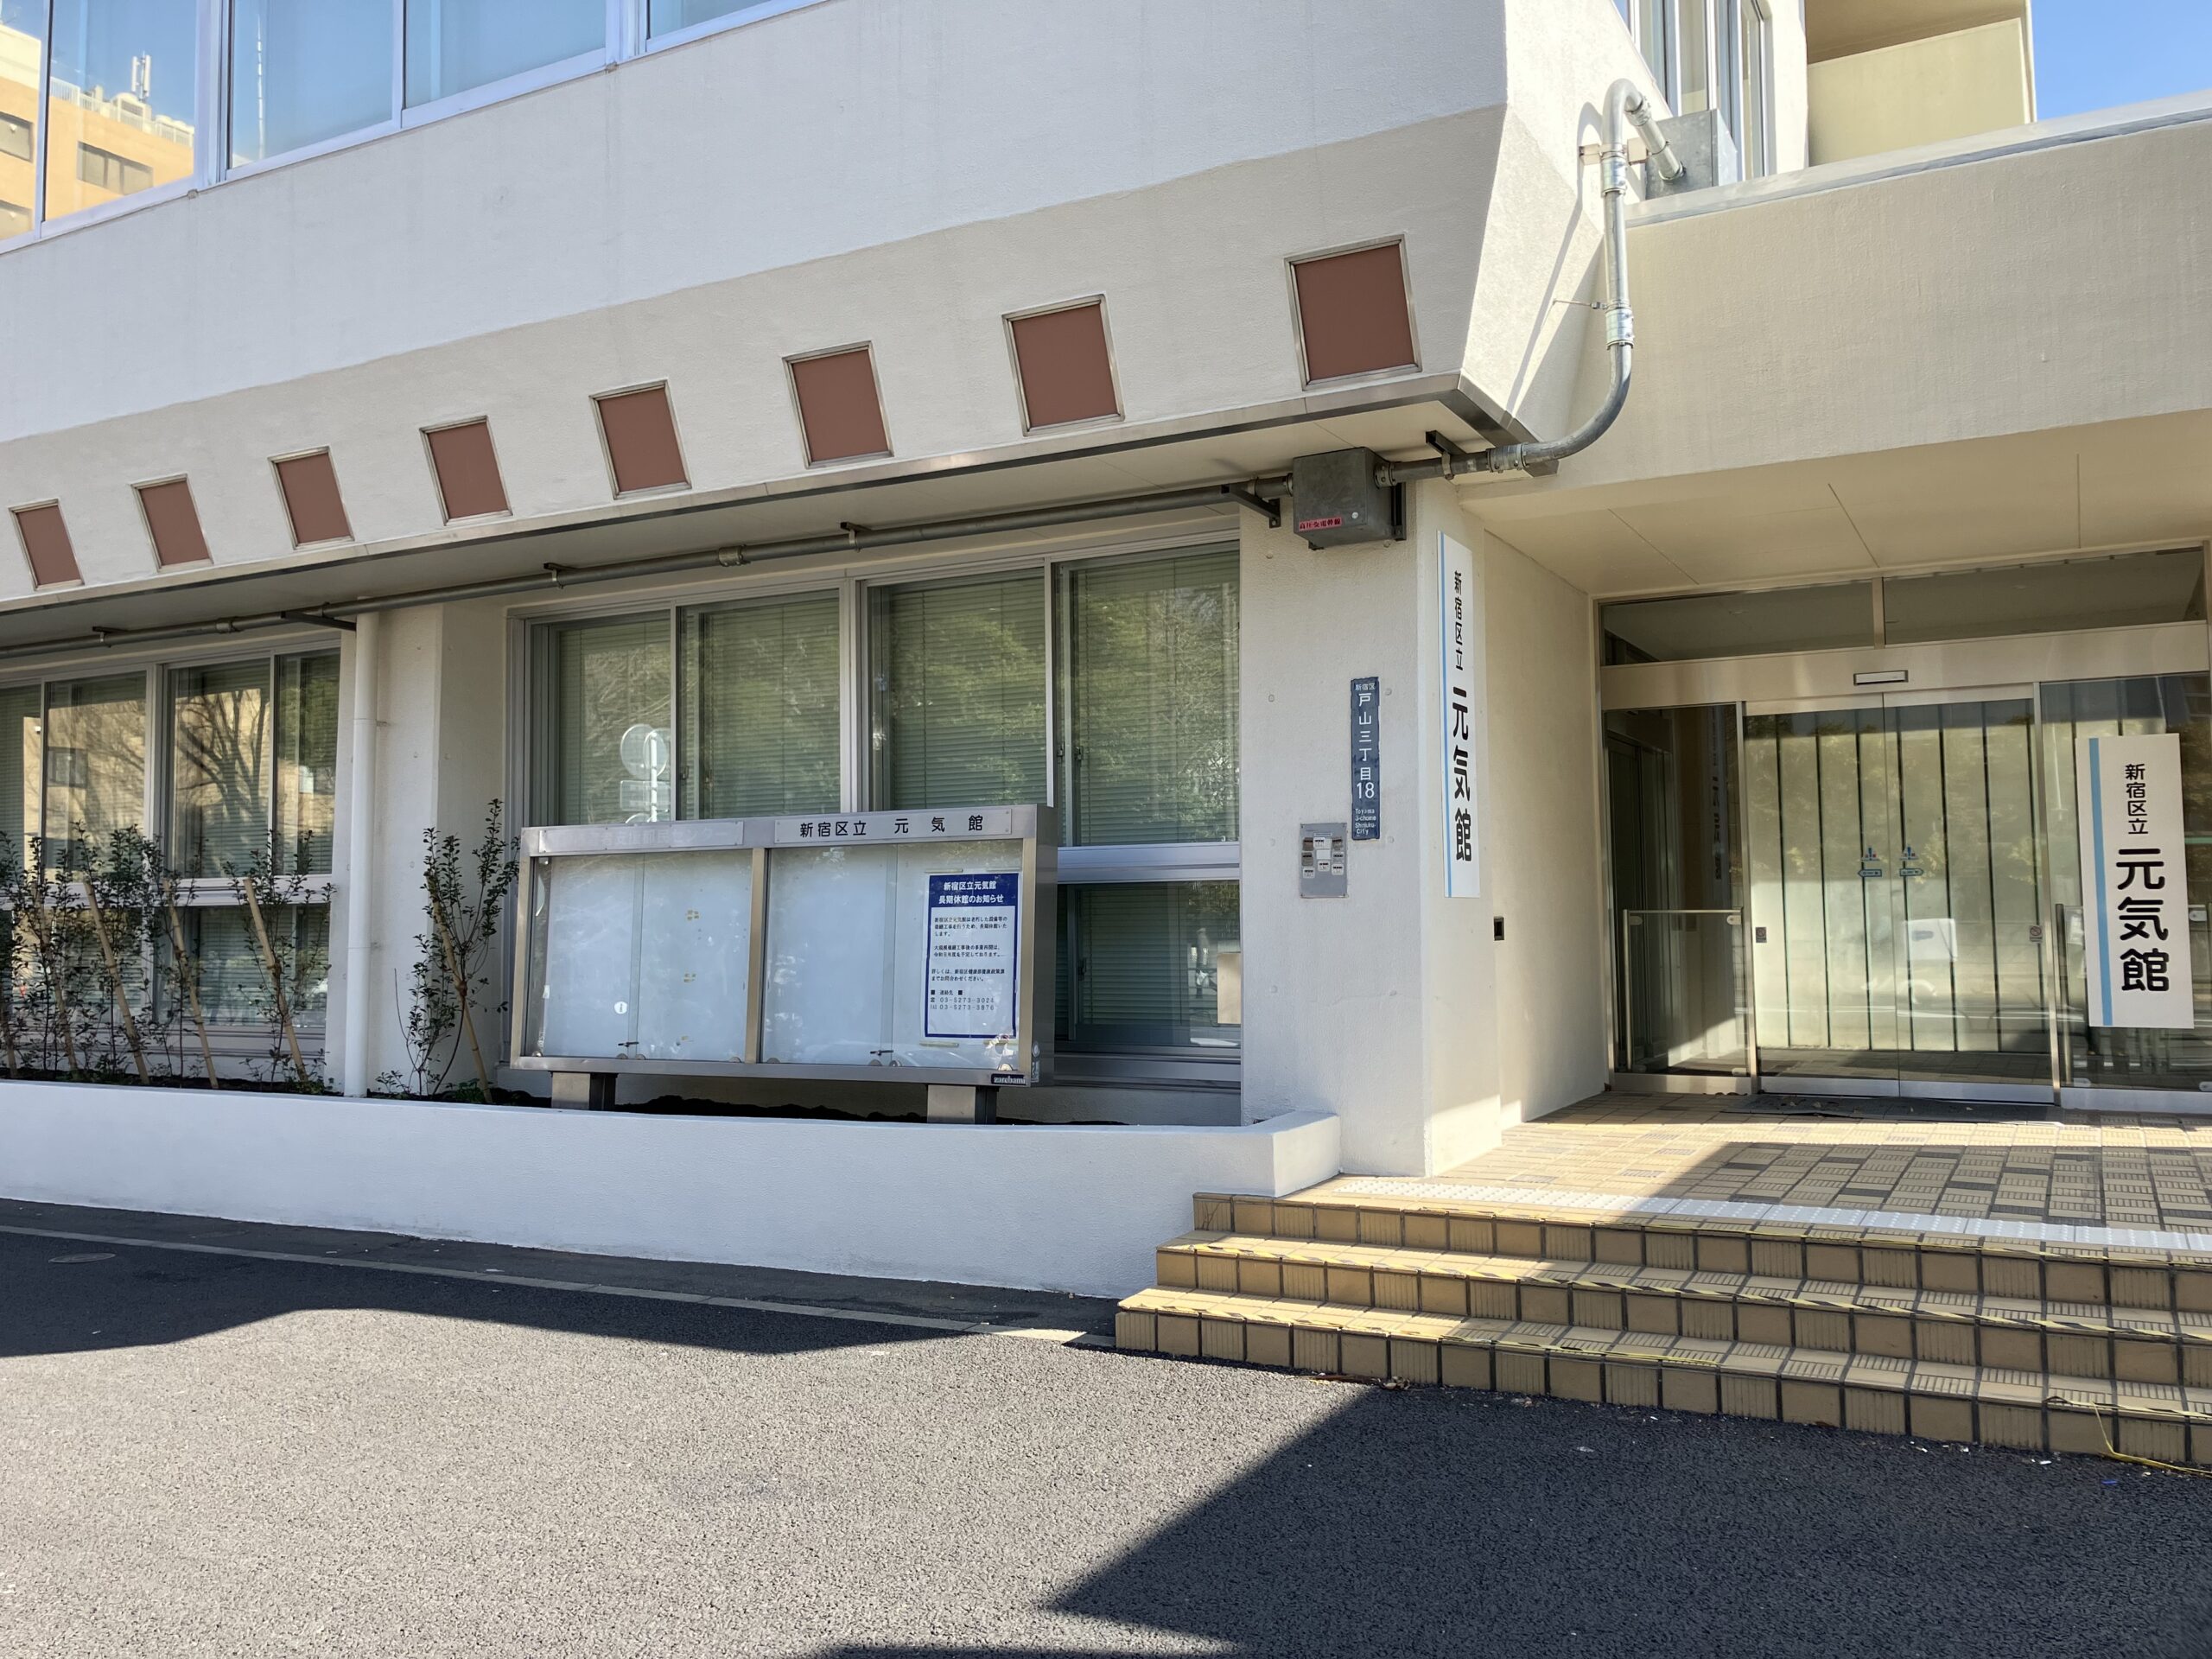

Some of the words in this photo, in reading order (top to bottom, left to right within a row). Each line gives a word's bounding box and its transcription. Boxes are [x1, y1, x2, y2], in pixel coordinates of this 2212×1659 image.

[1454, 570, 1464, 671] 新宿区立
[1355, 683, 1376, 691] 新宿区
[1452, 686, 1472, 862] 元気館
[2125, 763, 2149, 835] 新宿区立
[800, 820, 867, 838] 新宿区立
[894, 815, 983, 835] 元気館
[938, 893, 1004, 905] 長期休館のお知らせ
[944, 880, 997, 891] 新宿区立元気館
[2116, 848, 2170, 993] 元気館
